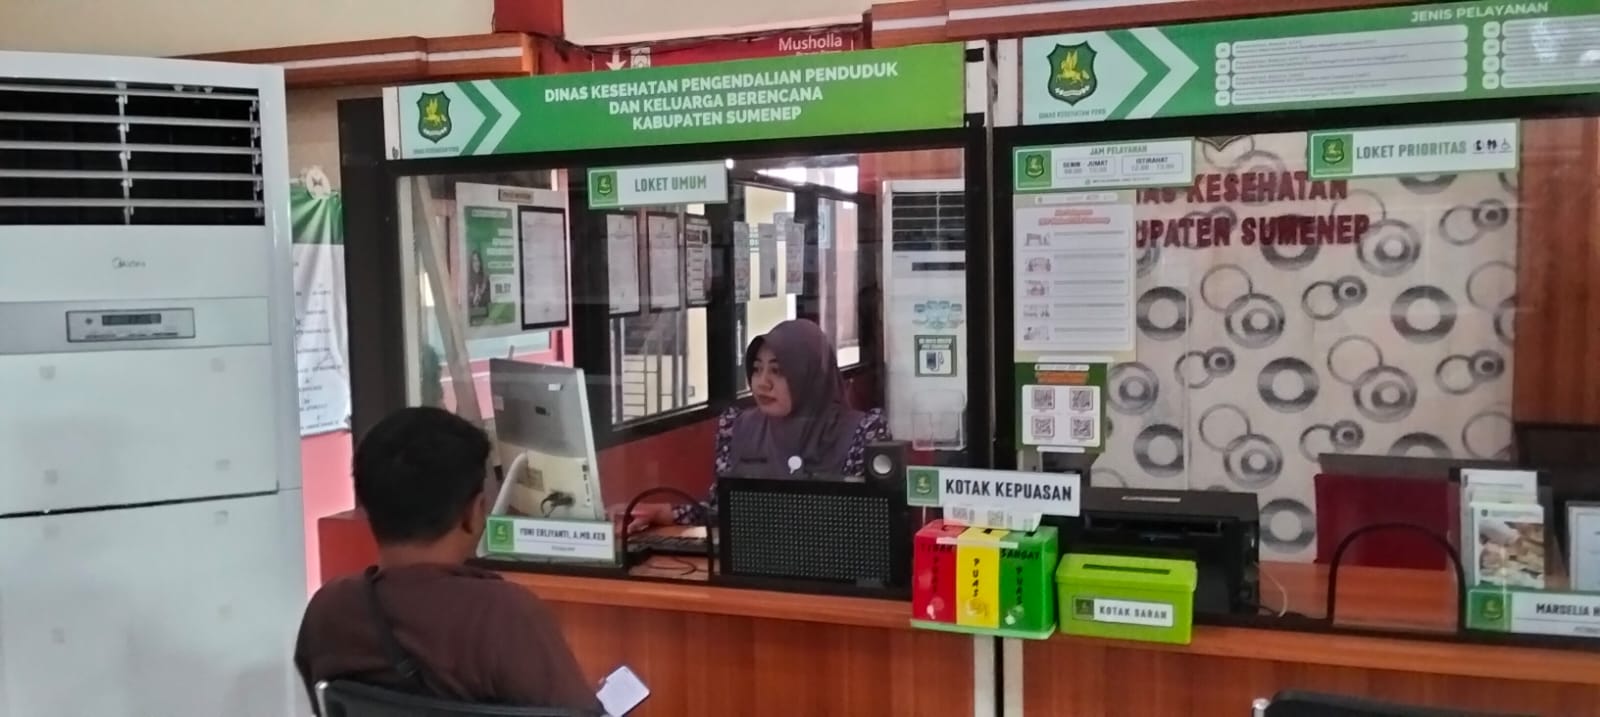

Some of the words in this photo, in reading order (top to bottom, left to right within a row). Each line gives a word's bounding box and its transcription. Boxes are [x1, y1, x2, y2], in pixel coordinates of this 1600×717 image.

[1411, 9, 1452, 22] JENIS
[1456, 2, 1548, 18] PELAYANAN
[778, 34, 843, 52] Musholla
[545, 85, 588, 103] DINAS
[591, 80, 678, 100] KESEHATAN
[681, 70, 802, 92] PENGENDALIAN
[805, 62, 898, 83] PENDUDUK
[609, 100, 640, 115] DAN
[643, 93, 723, 112] KELUARGA
[727, 86, 823, 107] BERENCANA
[632, 111, 723, 130] KABUPATEN
[726, 106, 802, 124] SUMENEP
[1090, 147, 1105, 156] JAM
[1107, 145, 1147, 154] PELAYANAN
[1356, 145, 1395, 160] LOKET
[1398, 141, 1467, 157] PRIORITAS
[634, 178, 668, 193] LOKET
[671, 175, 707, 191] UMUM
[1187, 170, 1347, 203] KESEHATAN
[1136, 216, 1230, 248] UPATEN
[1241, 213, 1370, 247] SUMENEP
[945, 479, 991, 497] KOTAK
[995, 481, 1072, 501] KEPUASAN
[972, 557, 980, 597] PUAS
[1099, 606, 1130, 616] KOTAK
[1135, 608, 1167, 619] SARAN
